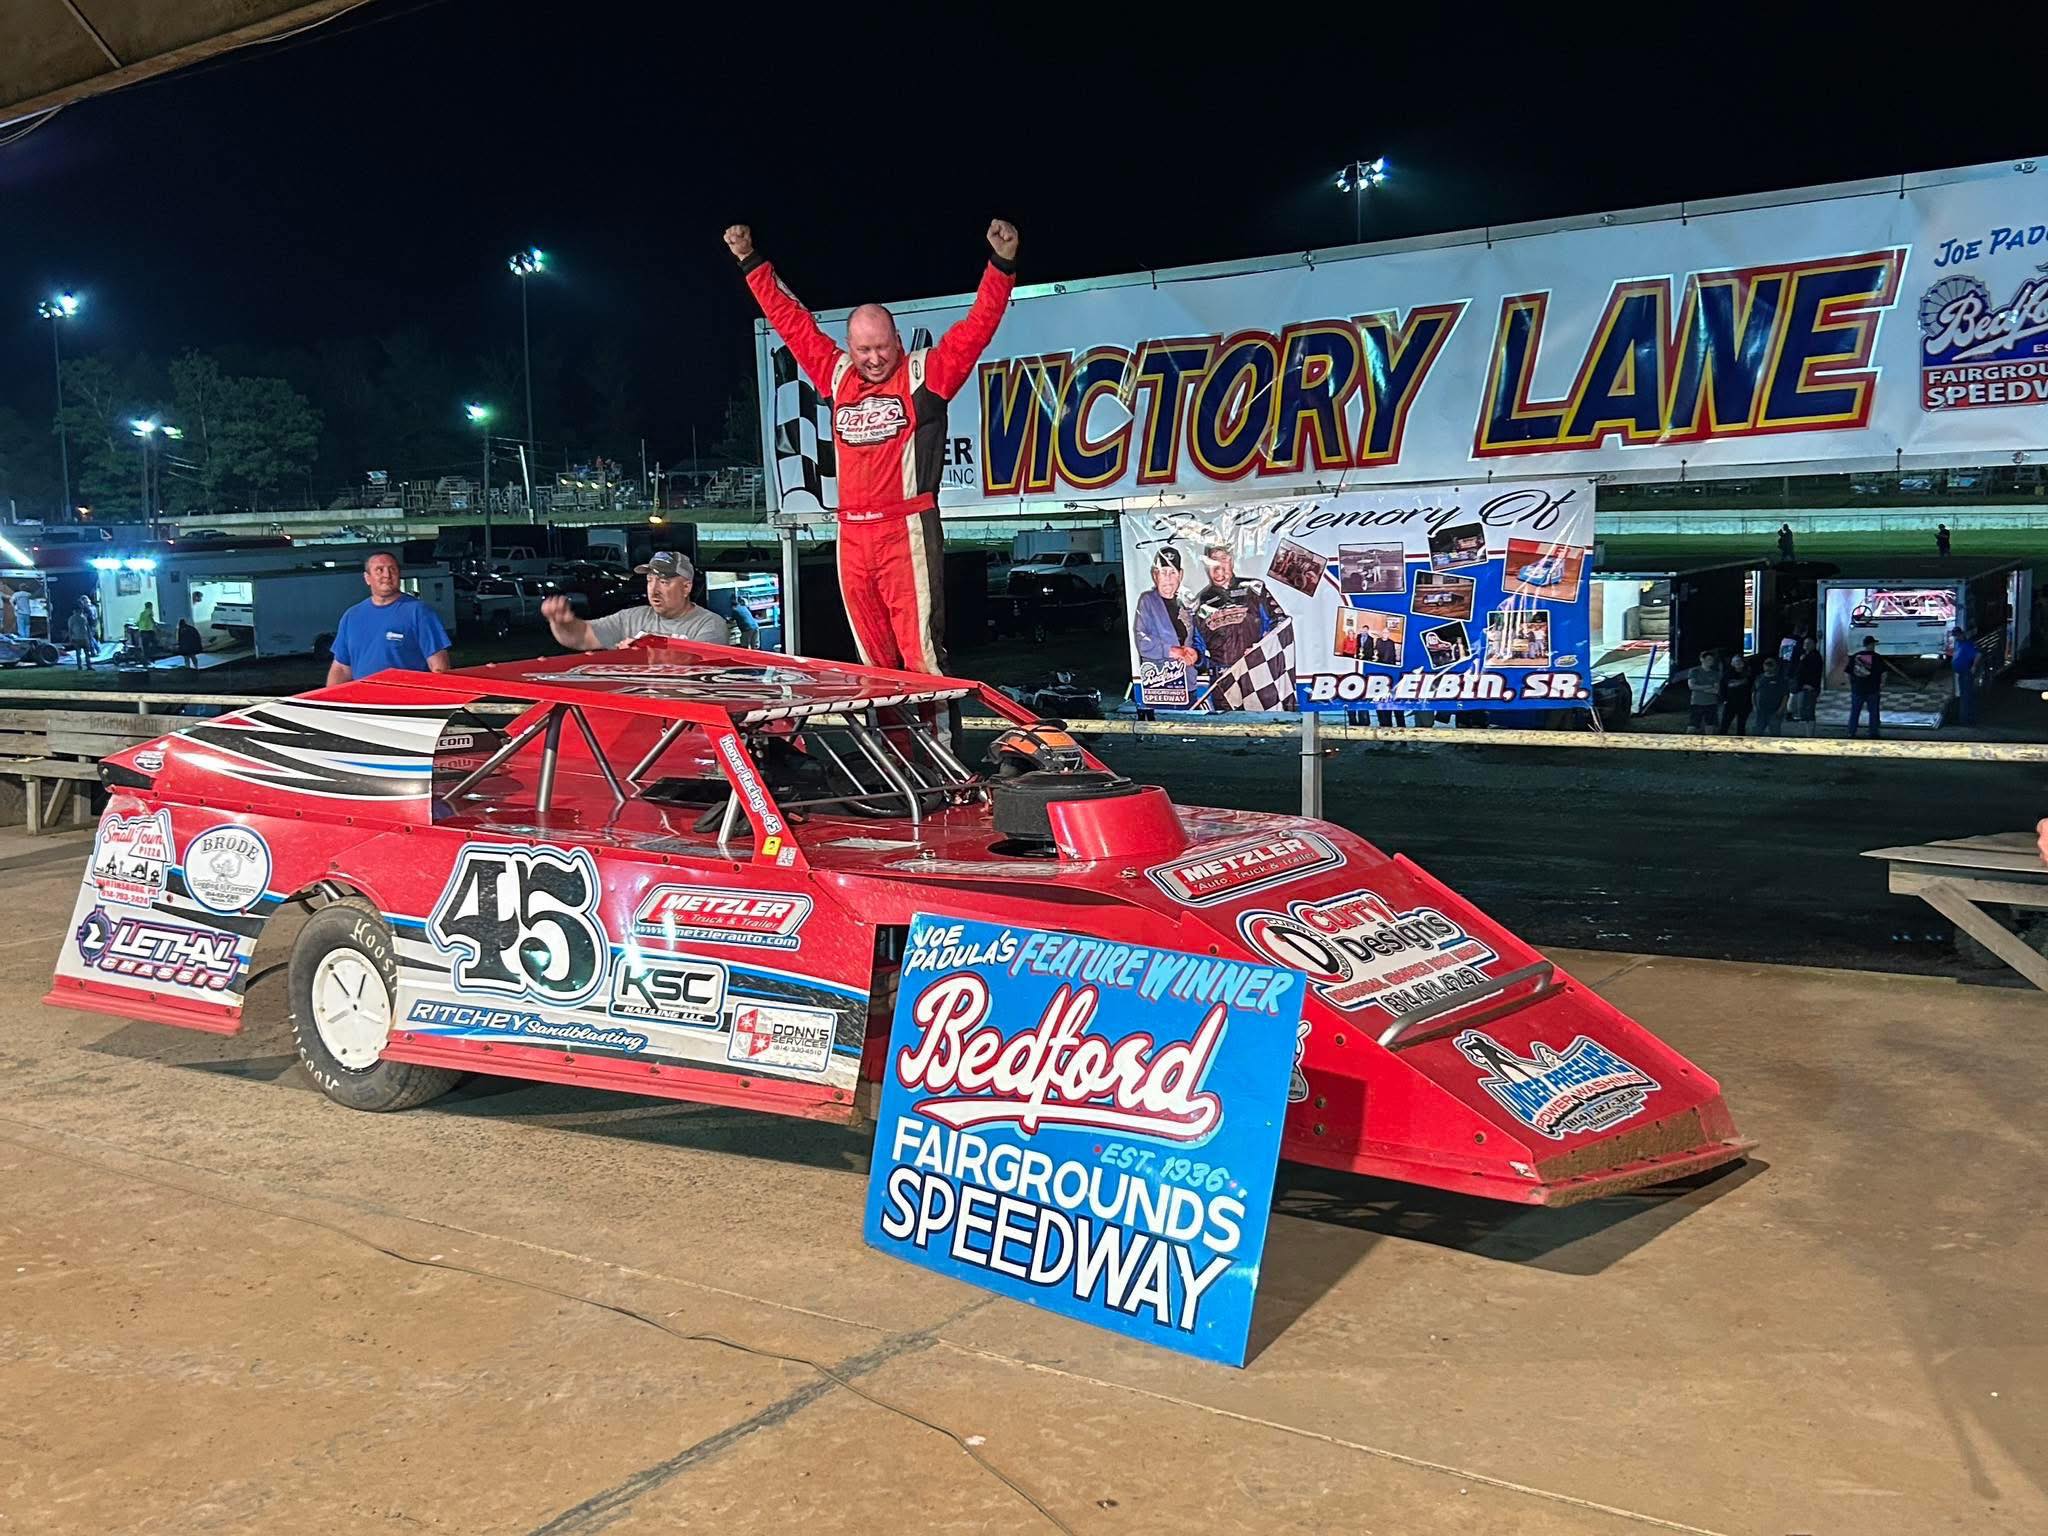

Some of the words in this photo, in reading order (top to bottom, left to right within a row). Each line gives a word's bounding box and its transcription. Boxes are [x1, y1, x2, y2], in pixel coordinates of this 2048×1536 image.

[1934, 239, 1983, 268] JOE
[1989, 224, 2048, 255] PAD
[979, 299, 1470, 497] VICTORY
[1471, 245, 1911, 460] LANE
[949, 468, 974, 485] INC
[1479, 489, 1577, 531] Of
[1145, 694, 1186, 702] SPEEDWAY
[1310, 674, 1392, 701] BOB
[1522, 673, 1590, 700] SR.
[721, 734, 746, 773] Hoover
[740, 770, 766, 811] Racing
[765, 814, 781, 835] 45
[103, 824, 134, 845] Small
[134, 825, 164, 846] Town
[139, 846, 161, 857] PIZZA
[203, 836, 260, 861] BRODE
[1181, 839, 1307, 884] METZLER
[1198, 877, 1232, 892] Auto,
[1235, 865, 1267, 880] Truck
[1283, 851, 1317, 866] Trailer
[438, 857, 598, 993] 45
[661, 893, 792, 919] METZLER
[692, 913, 723, 924] Truck
[741, 917, 780, 929] Trailer
[1301, 895, 1396, 935] Curry
[110, 925, 232, 971] LETHAL
[636, 924, 797, 948] wwwmetzlerauto.com
[912, 924, 964, 949] JOE
[1333, 911, 1455, 963] Designs
[100, 956, 229, 989] CHASSIS
[621, 965, 717, 1011] KSC
[904, 929, 1019, 977] PADULA'S
[1008, 933, 1148, 989] FEATURE
[1138, 951, 1296, 1016] WINNER
[410, 1003, 530, 1031] RITCHEY
[524, 1019, 645, 1051] Sandblasting
[623, 1005, 679, 1019] HAULING
[681, 1013, 705, 1022] LLC
[773, 1023, 830, 1041] DONN'S
[771, 1035, 828, 1049] SERVICES
[900, 970, 1230, 1138] Bedford
[1502, 1076, 1552, 1122] UNDER
[1544, 1043, 1634, 1095] PRESSURE
[1535, 1094, 1581, 1129] POWER
[1570, 1073, 1647, 1099] WASHING
[891, 1115, 1247, 1254] FAIRGROUNDS
[1100, 1143, 1156, 1174] EST.
[1160, 1156, 1231, 1193] 1936
[880, 1166, 1236, 1336] SPEEDWAY
